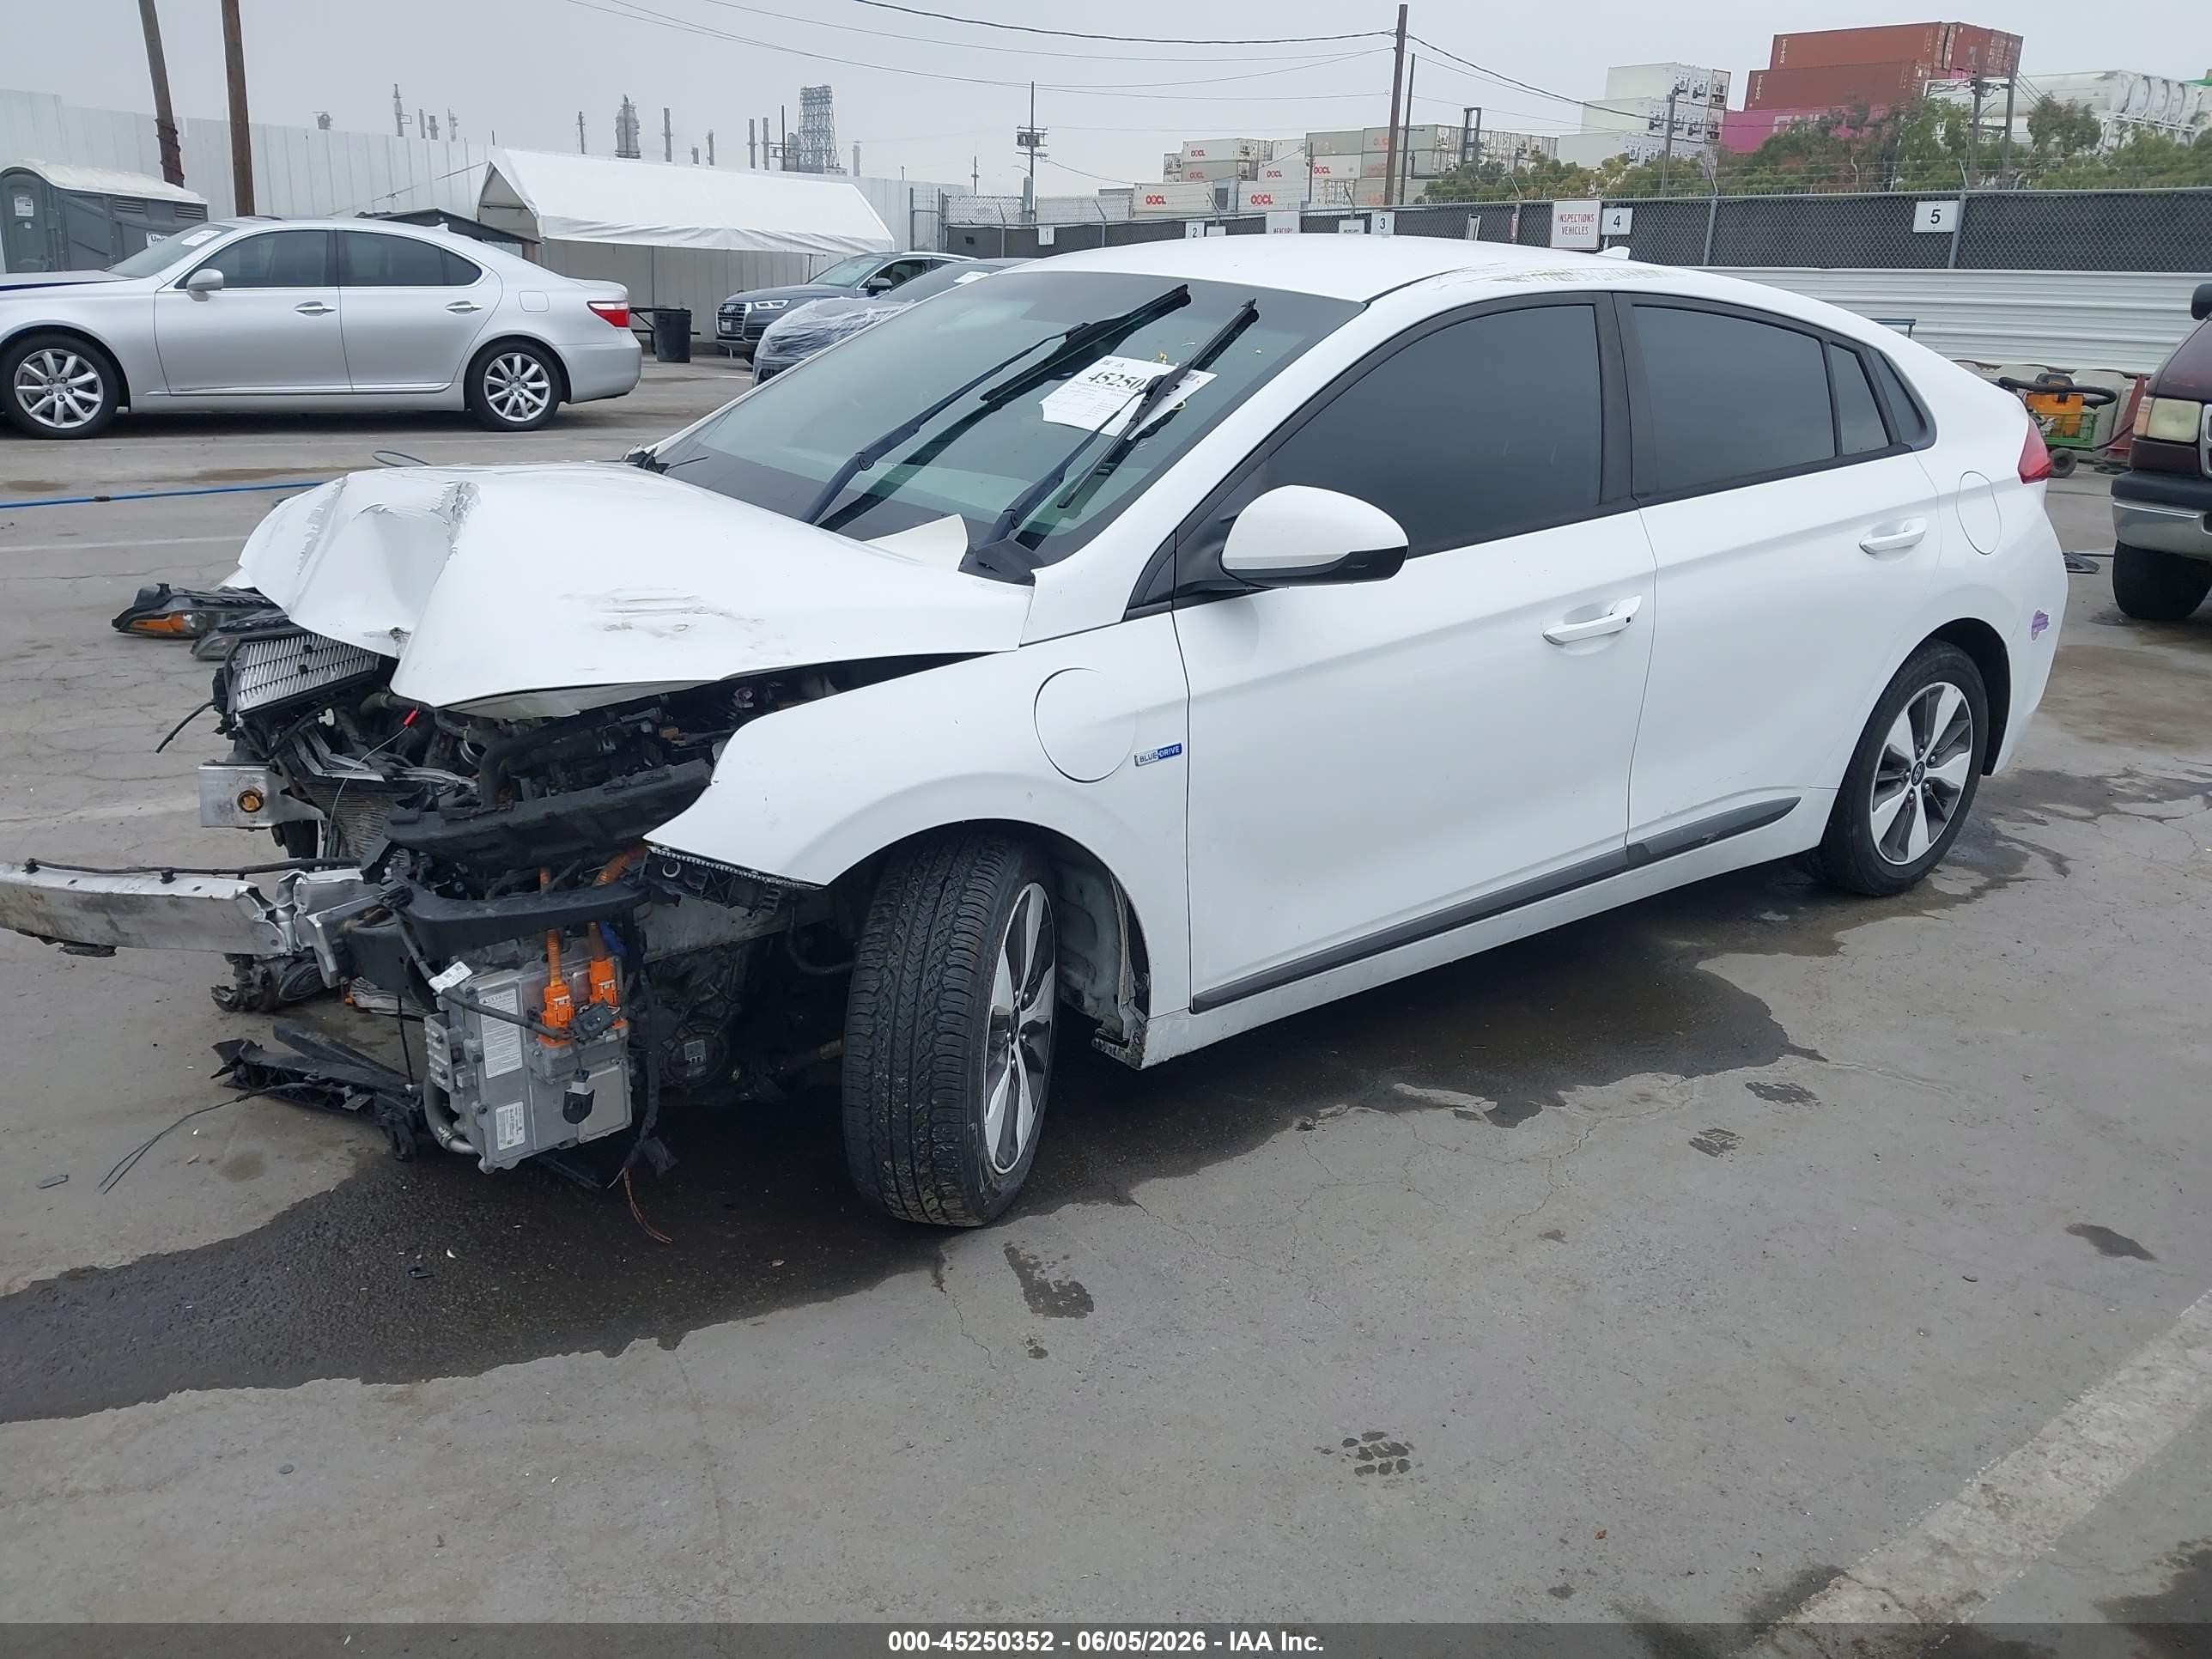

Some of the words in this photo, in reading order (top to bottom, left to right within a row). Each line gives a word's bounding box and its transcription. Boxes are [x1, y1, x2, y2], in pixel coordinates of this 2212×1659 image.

[1313, 166, 1331, 174] OOCL
[1146, 194, 1166, 205] OOCL
[1250, 193, 1273, 205] OOCL
[1558, 213, 1595, 222] INSPECTIONS
[1613, 215, 1620, 228] 4
[1929, 209, 1942, 224] 5
[1379, 217, 1386, 230] 3
[1192, 227, 1198, 238] 2
[1561, 226, 1589, 235] VEHICLES
[1139, 751, 1158, 763] BLUE
[1158, 745, 1180, 757] DRIVE
